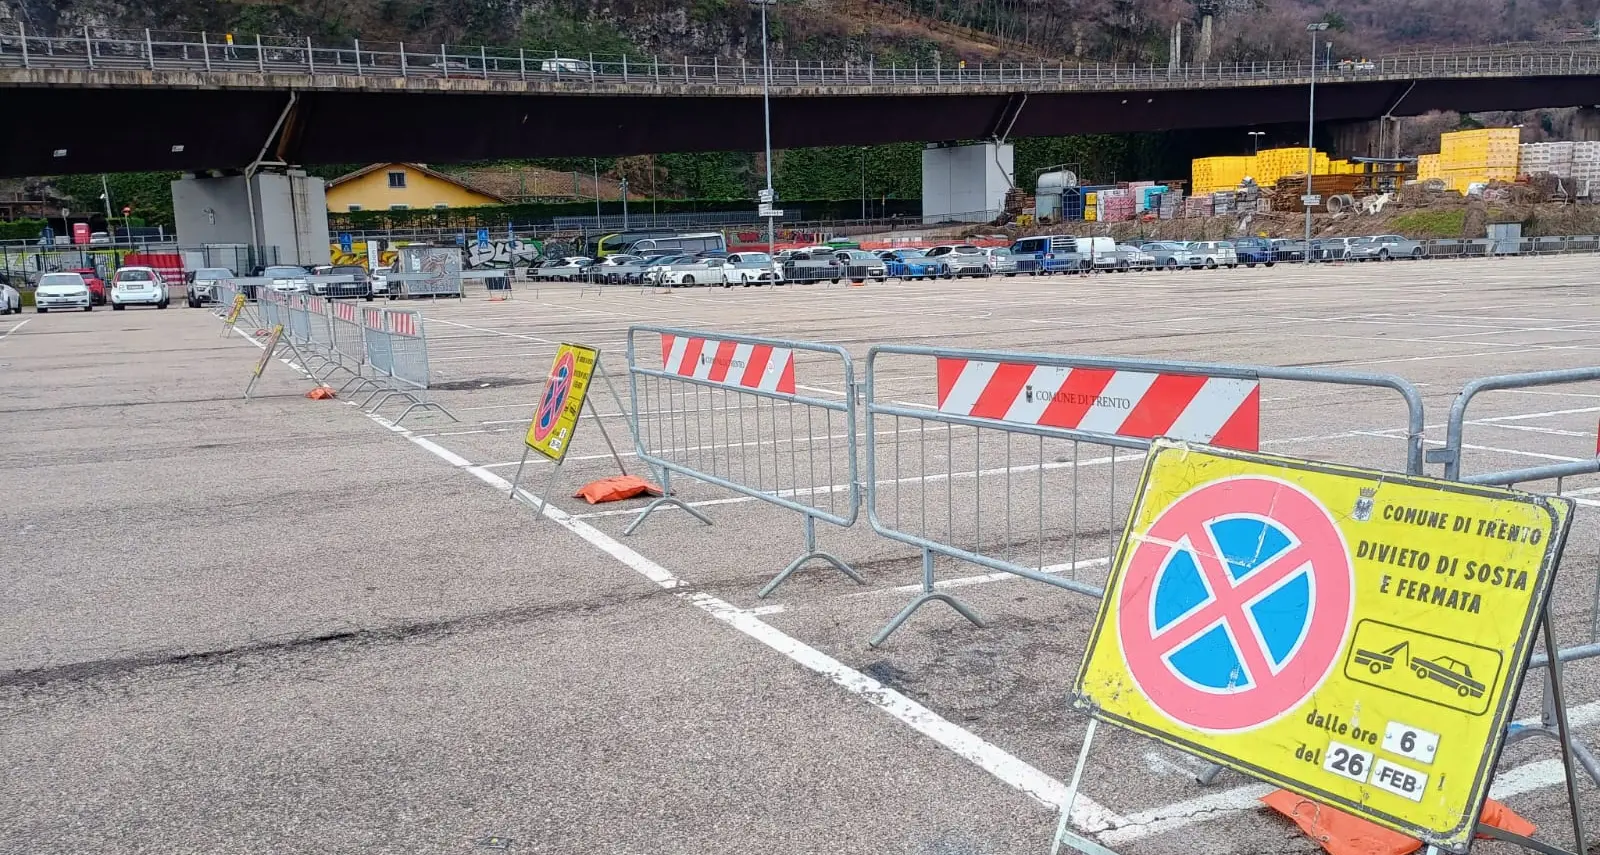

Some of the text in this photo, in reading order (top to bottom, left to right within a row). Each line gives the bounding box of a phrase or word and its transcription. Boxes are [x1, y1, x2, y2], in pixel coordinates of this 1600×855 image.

[1035, 390, 1131, 410] COMUNE DI TRENTO
[1383, 504, 1542, 546] COMUNE DI TRENTO
[1356, 540, 1528, 591] DIVIETO DI SOSTA
[1380, 575, 1481, 614] E FERMATA
[1306, 708, 1417, 753] dalle ore 6
[1295, 744, 1321, 765] del
[1331, 748, 1365, 776] 26
[1379, 766, 1418, 793] FEB
